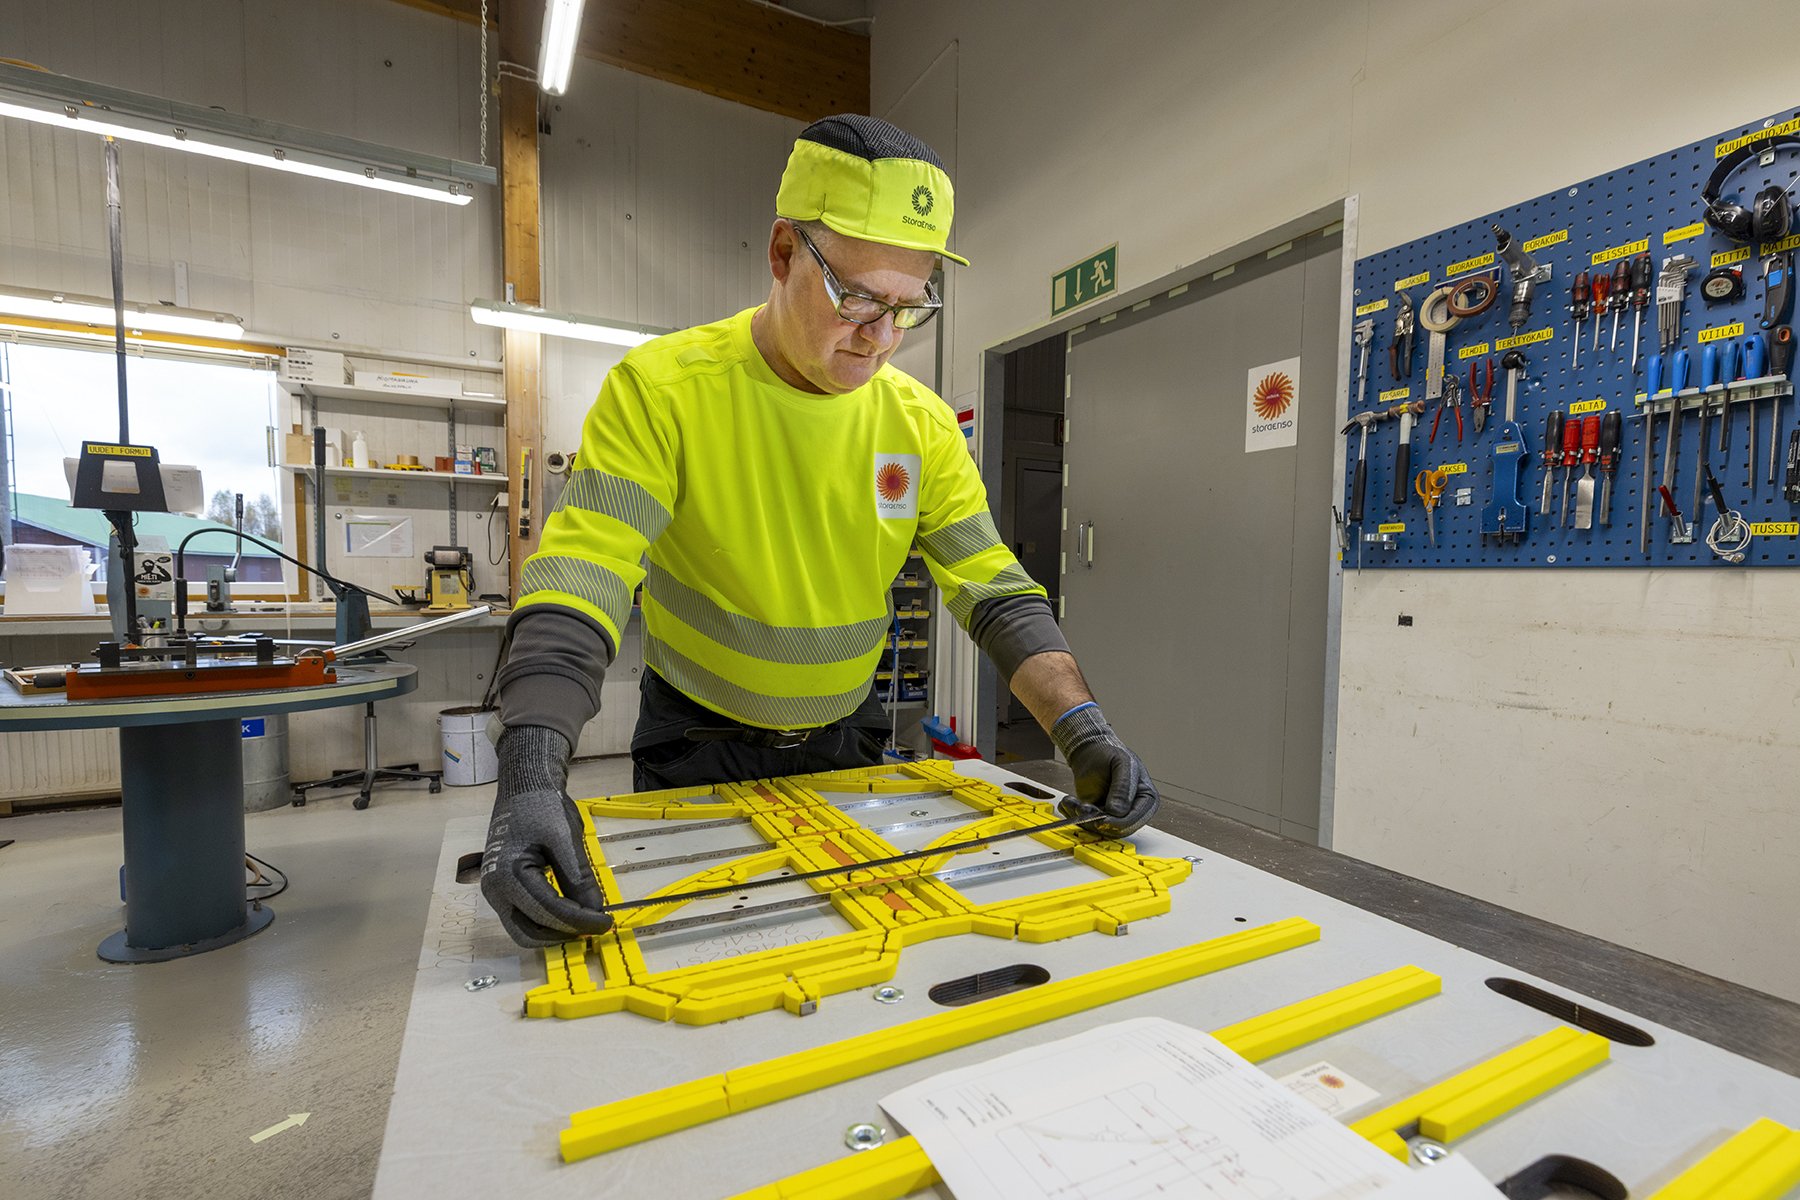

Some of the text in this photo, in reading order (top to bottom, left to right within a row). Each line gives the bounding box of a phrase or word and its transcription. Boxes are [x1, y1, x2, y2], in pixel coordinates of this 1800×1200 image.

[1717, 118, 1800, 156] KUULOSUOJAI
[1593, 242, 1648, 263] MEISSELIT
[1713, 249, 1749, 266] MITTA
[1448, 255, 1494, 274] SUORAKULMA
[1701, 324, 1743, 341] VIILAT
[1460, 345, 1488, 358] PIHDIT
[1571, 401, 1605, 413] TALTAT
[89, 445, 150, 456] UUDET FORMUT
[1440, 464, 1466, 474] SAKSET
[1753, 524, 1798, 534] TUSSIT
